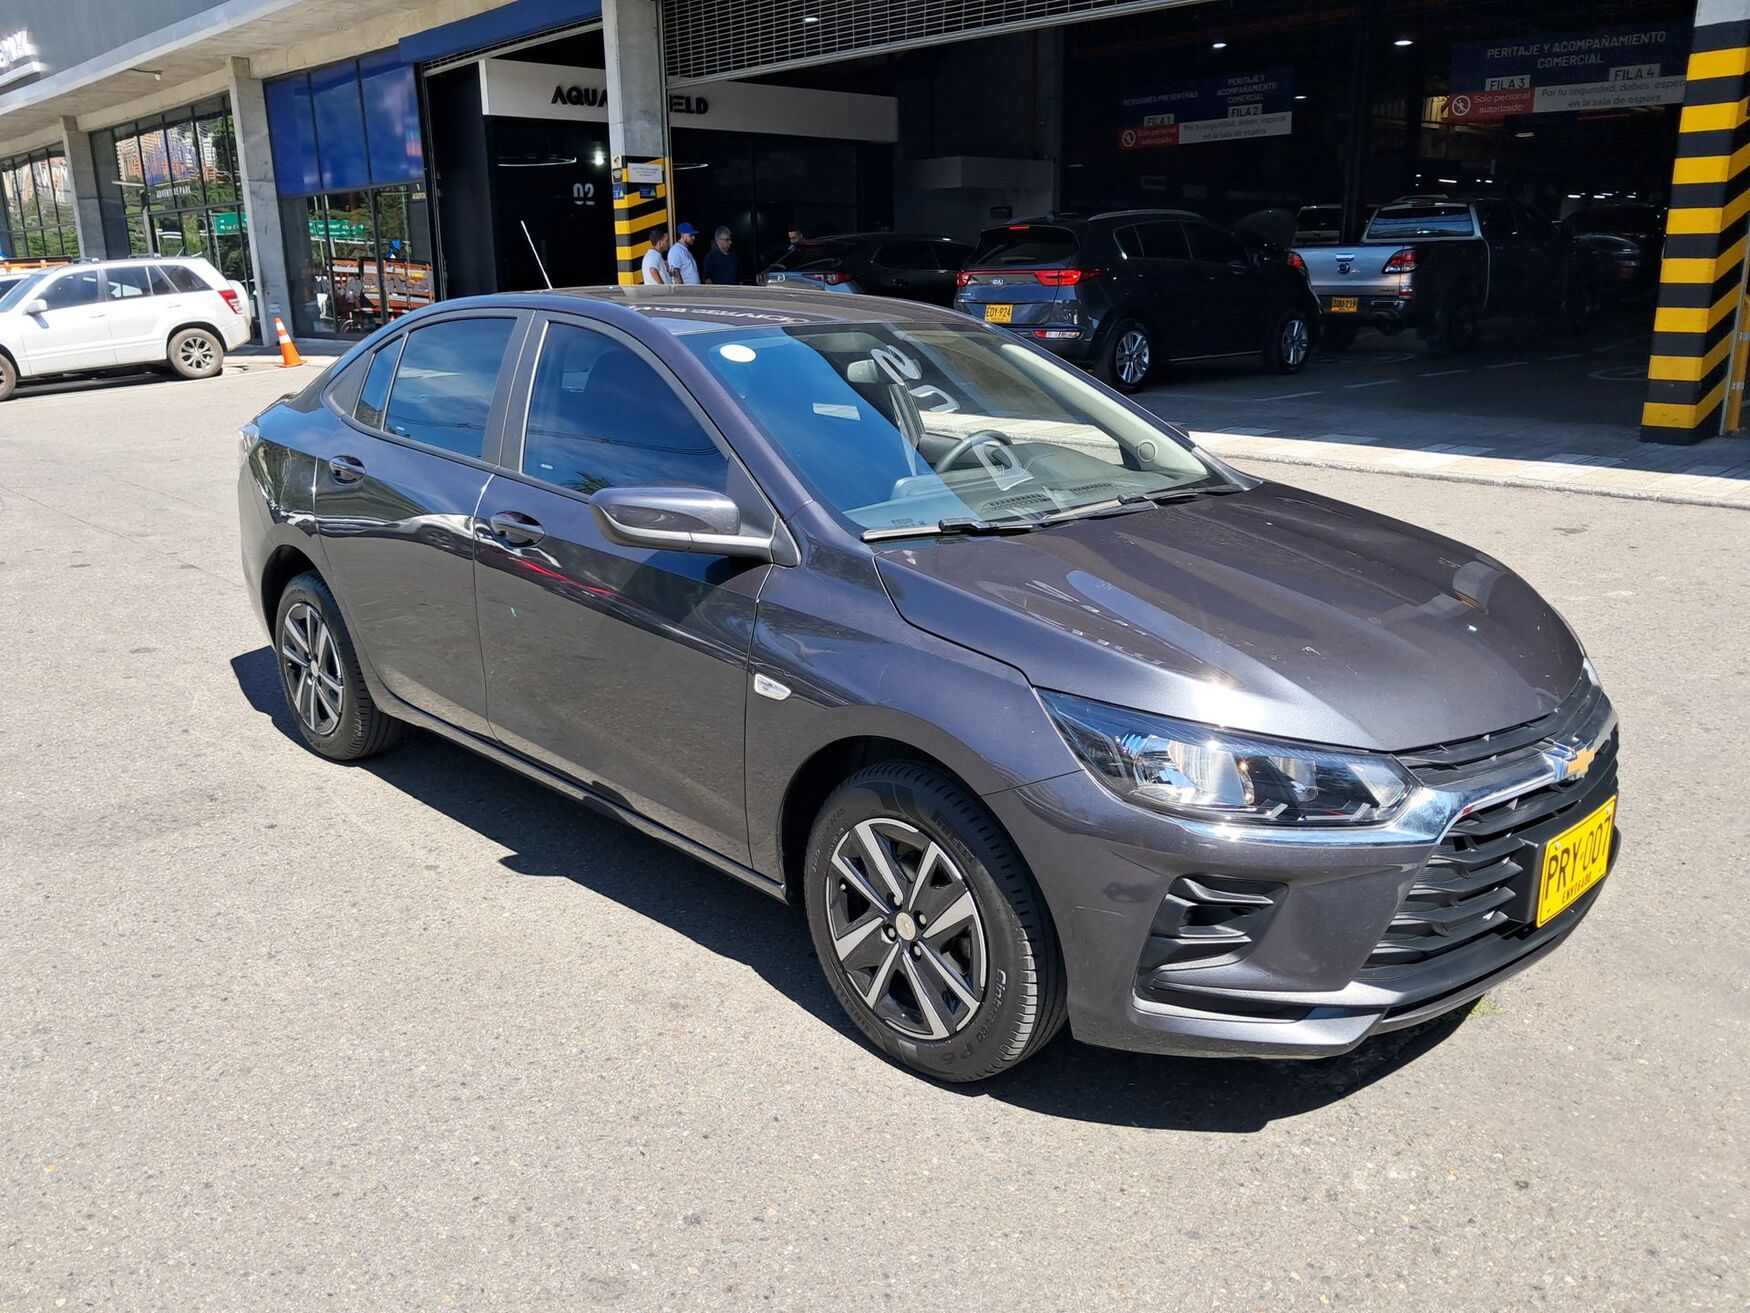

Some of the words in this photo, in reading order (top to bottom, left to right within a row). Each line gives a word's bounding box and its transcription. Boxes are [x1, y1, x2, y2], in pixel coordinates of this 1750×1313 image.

[1487, 43, 1540, 59] PERITAJE
[1543, 42, 1551, 54] Y
[1552, 30, 1666, 53] ACOMPAÑAMIENTO
[1538, 53, 1603, 69] COMERCIAL
[1614, 69, 1643, 81] FILA
[1646, 67, 1655, 78] 4
[1489, 79, 1516, 90] FILA
[1518, 78, 1525, 88] 3
[1493, 92, 1531, 104] personal
[1231, 106, 1251, 117] FILA
[1479, 104, 1523, 114] autorizado
[573, 182, 595, 206] 02
